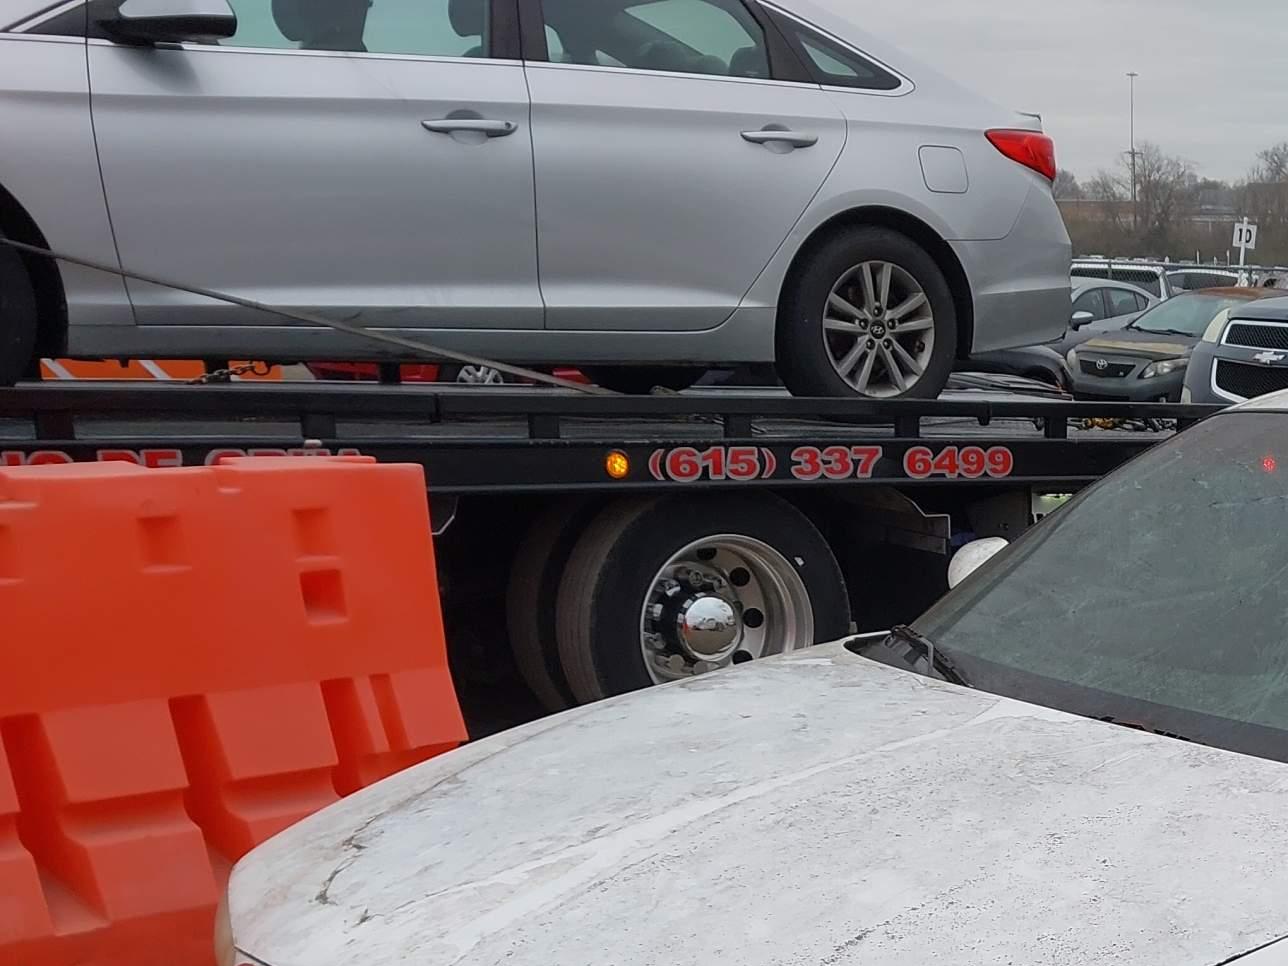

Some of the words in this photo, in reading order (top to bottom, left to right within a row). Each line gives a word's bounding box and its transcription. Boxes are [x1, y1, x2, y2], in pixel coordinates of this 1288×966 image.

[648, 446, 777, 482] (615)
[790, 446, 882, 480] 337
[903, 446, 1013, 479] 6499
